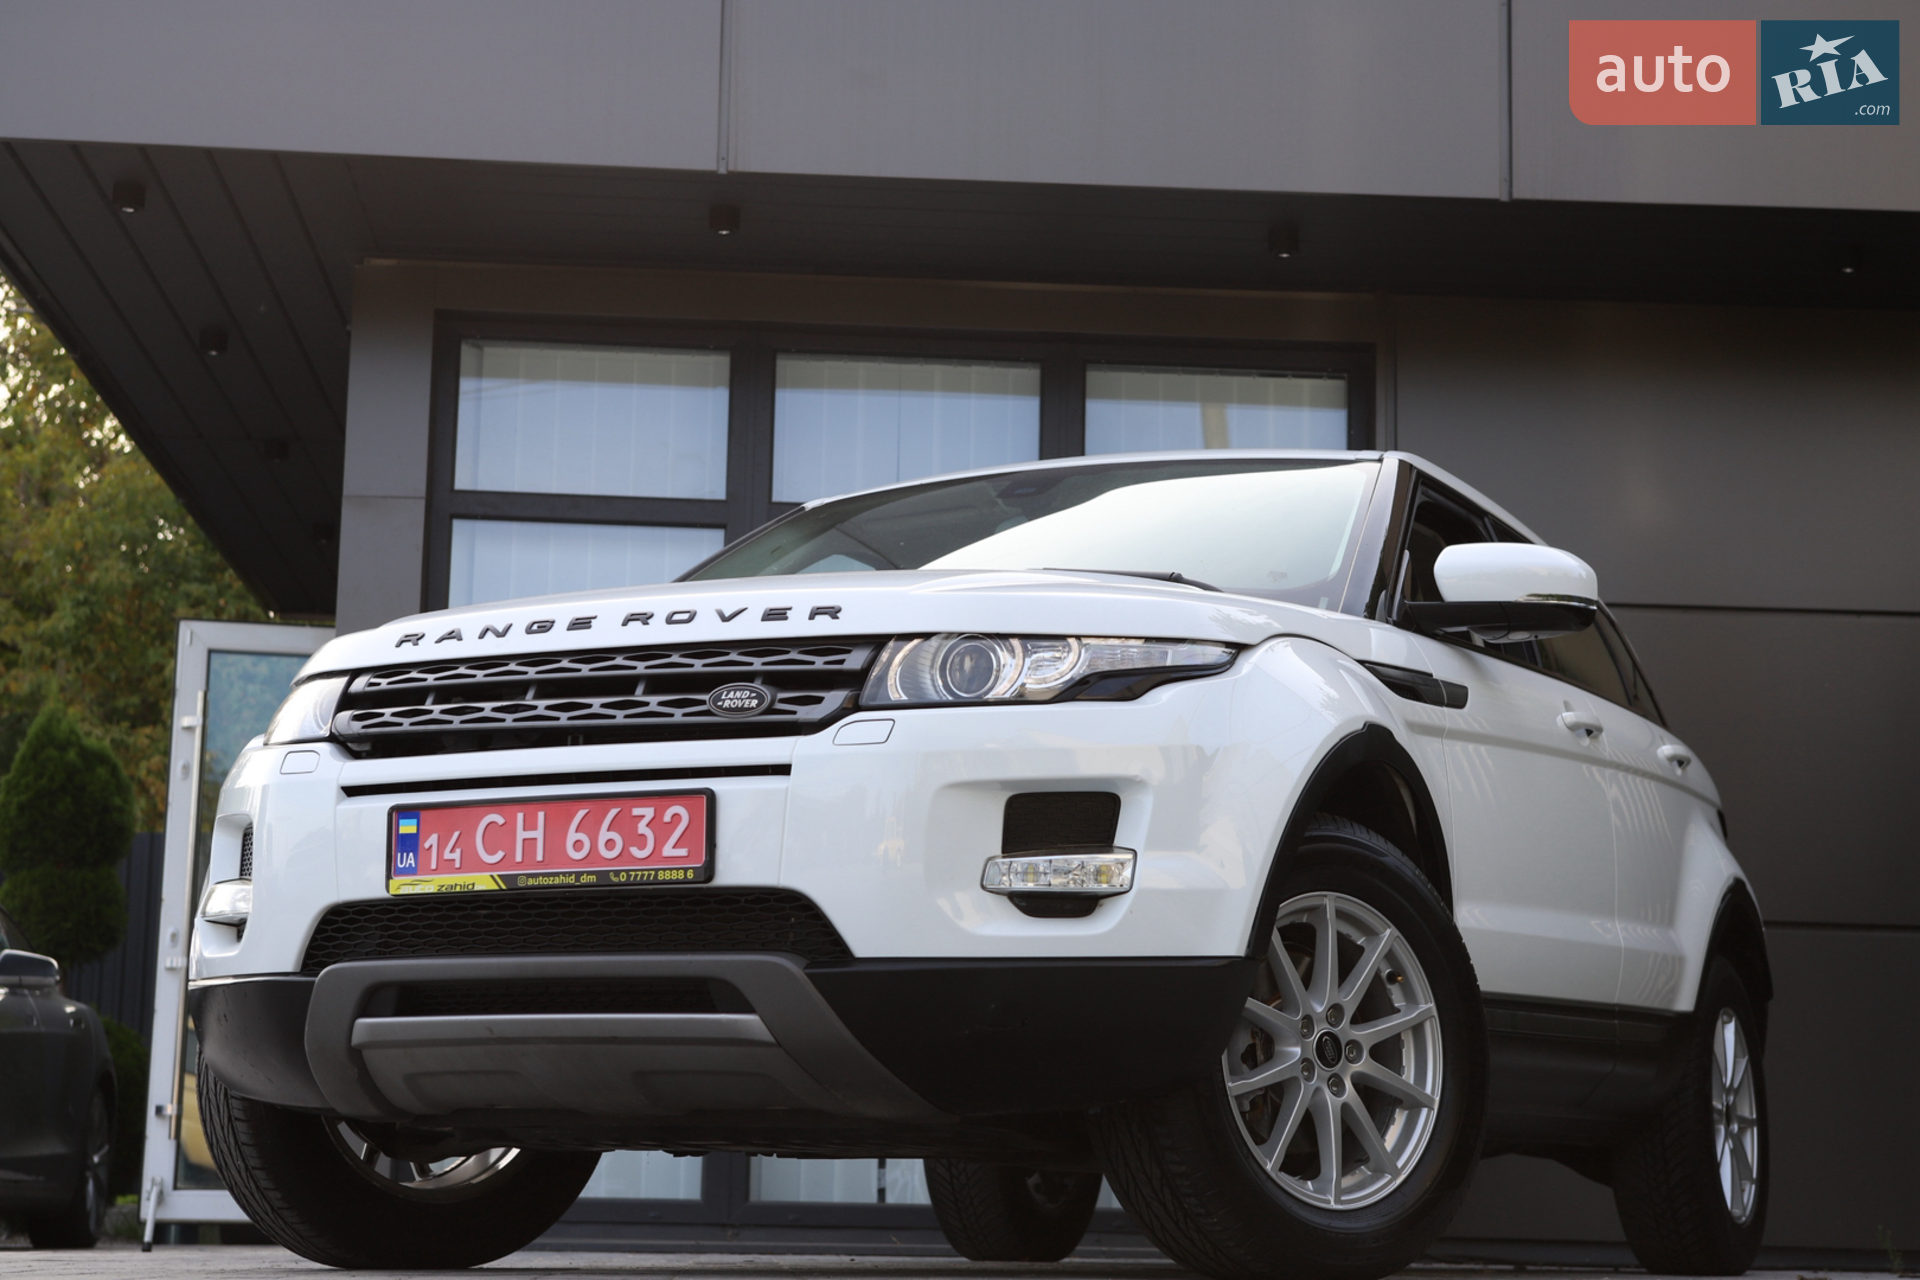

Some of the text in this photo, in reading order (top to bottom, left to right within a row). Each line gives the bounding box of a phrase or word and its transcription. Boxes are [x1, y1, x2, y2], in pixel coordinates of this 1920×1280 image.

[394, 605, 842, 648] RANGE ROVER
[423, 805, 691, 870] 14 CH 6632
[396, 851, 416, 868] UA
[629, 871, 656, 881] 7777
[657, 869, 685, 880] 8888
[437, 882, 476, 892] zahid
